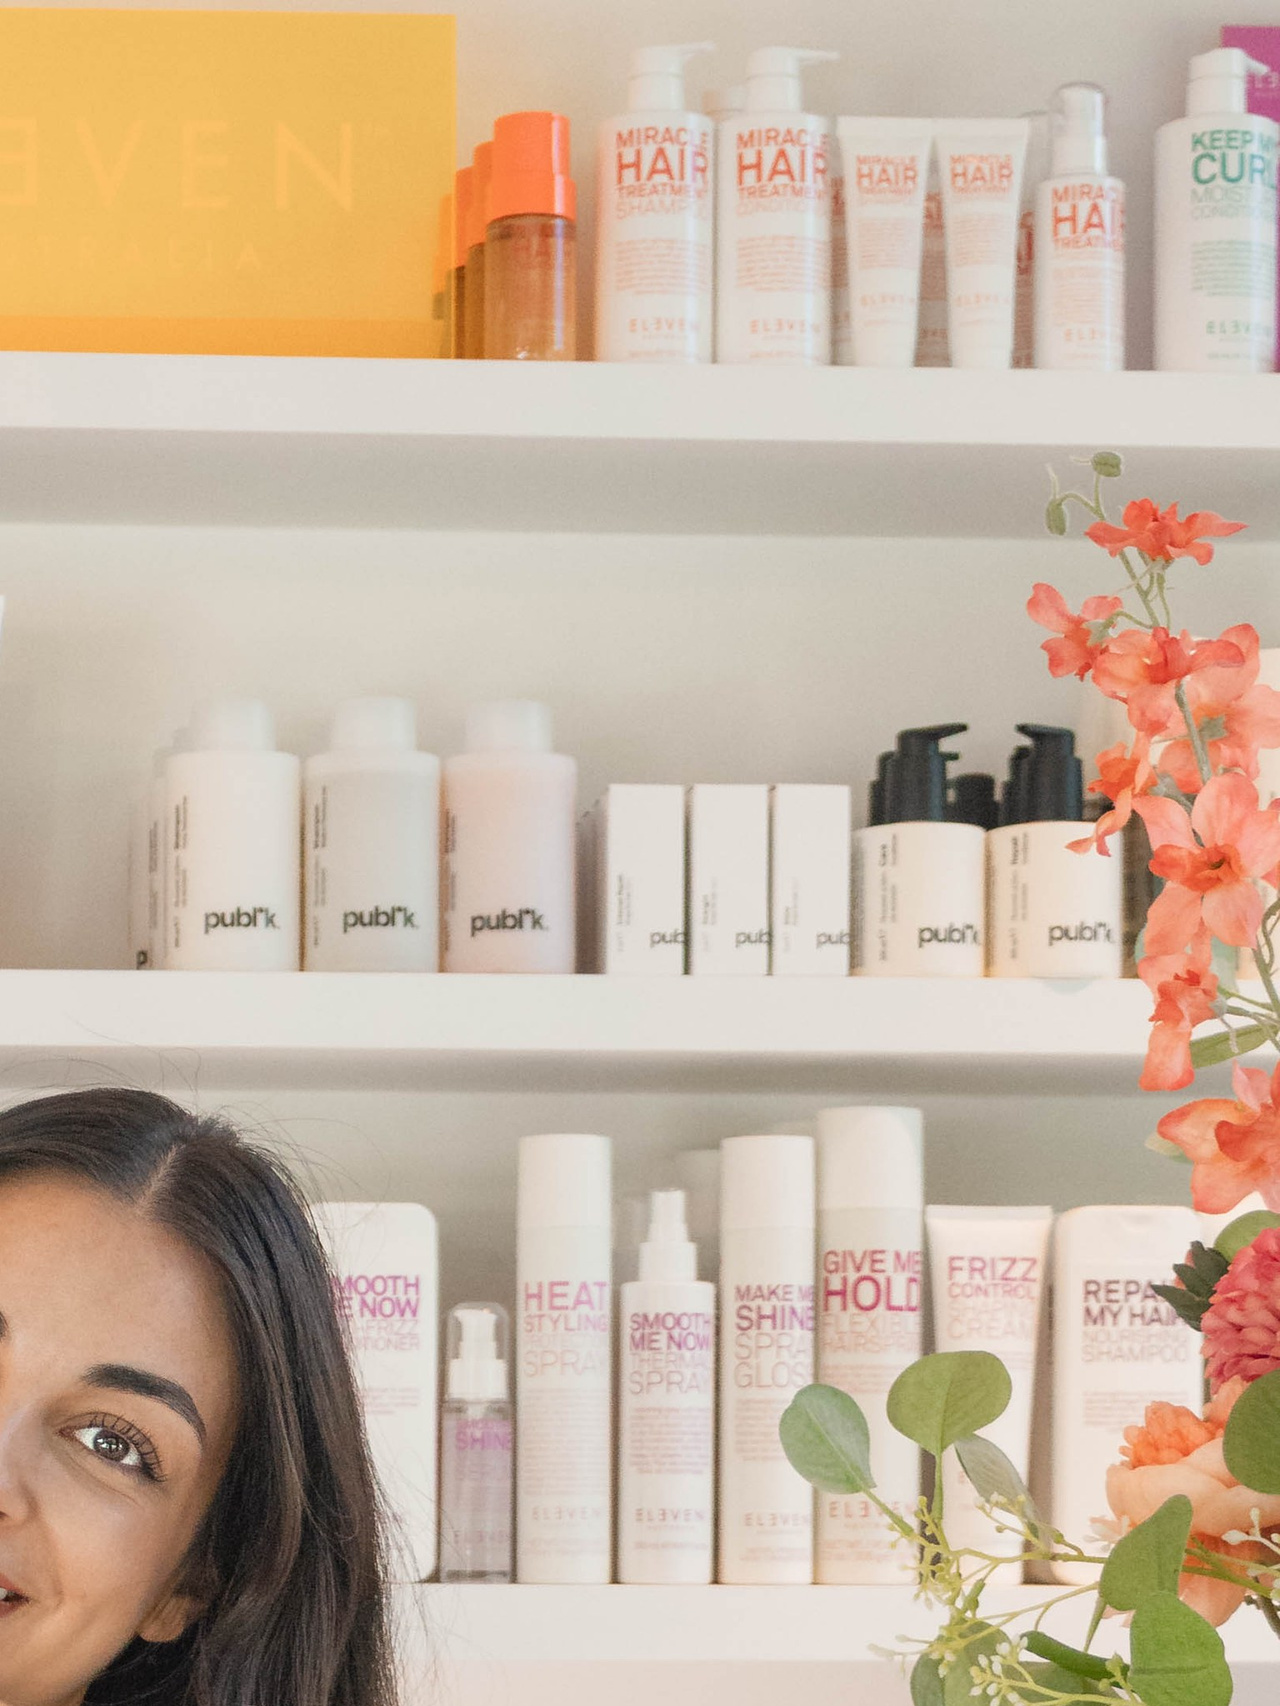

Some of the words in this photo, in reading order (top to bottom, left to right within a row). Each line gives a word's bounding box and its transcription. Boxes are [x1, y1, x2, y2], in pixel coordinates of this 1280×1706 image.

[616, 127, 708, 151] MIRACLE
[1191, 129, 1253, 151] KEEP
[616, 146, 708, 185] HAIR
[737, 148, 828, 187] HAIR
[856, 166, 917, 188] HAIR
[950, 165, 1013, 188] HAIR
[1191, 152, 1277, 191] CURL
[823, 1250, 887, 1274] GIVE
[893, 1250, 921, 1274] ME
[948, 1256, 1037, 1282] FRIZZ
[524, 1281, 607, 1311] HEAT
[735, 1284, 794, 1303] MAKE
[823, 1276, 920, 1312] HOLD
[949, 1283, 1036, 1300] CONTROL
[1084, 1279, 1160, 1303] REPA
[360, 1297, 420, 1318] NOW
[735, 1306, 816, 1332] SHINE
[1084, 1305, 1123, 1327] MY
[524, 1313, 609, 1333] STYLING
[630, 1313, 711, 1332] SMOOTH
[948, 1319, 1034, 1341] CREAM
[630, 1332, 660, 1351] ME
[666, 1333, 710, 1352] NOW
[1082, 1345, 1188, 1363] SHAMPOO
[735, 1362, 810, 1389] GLOS
